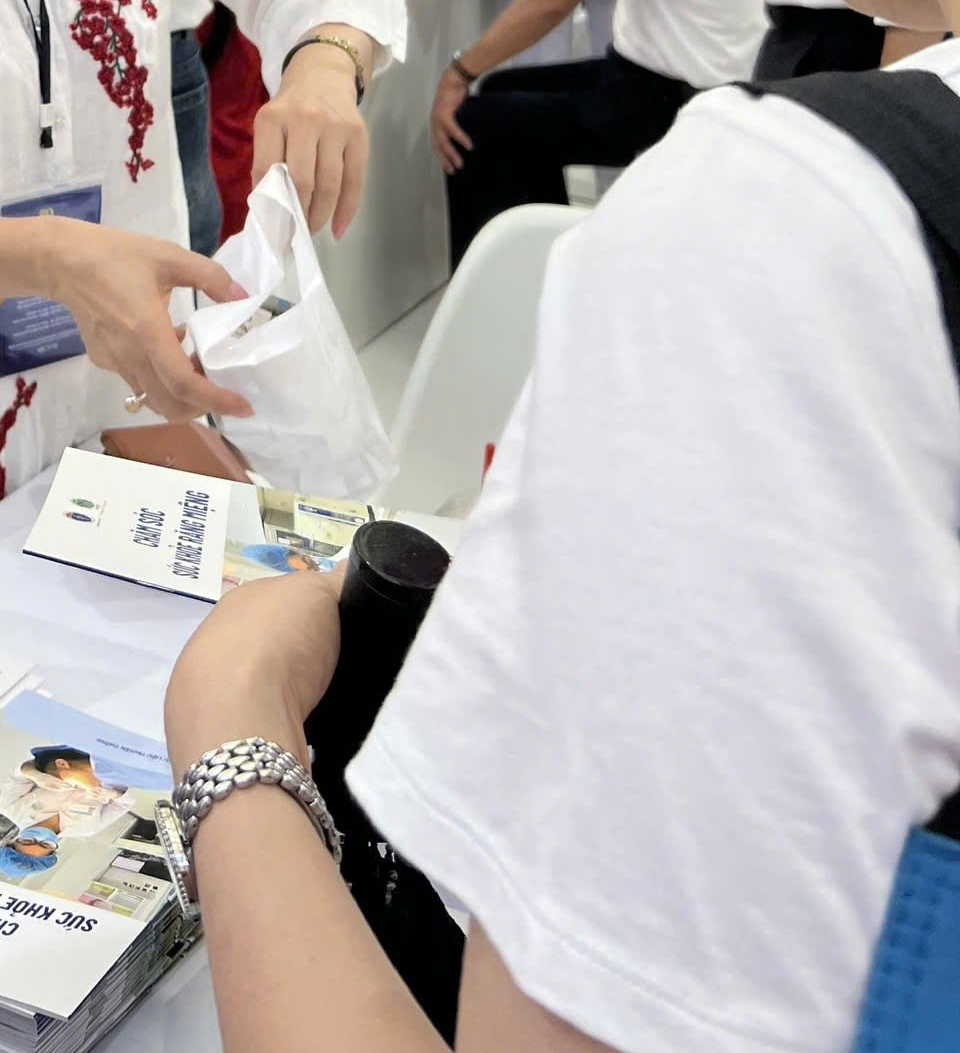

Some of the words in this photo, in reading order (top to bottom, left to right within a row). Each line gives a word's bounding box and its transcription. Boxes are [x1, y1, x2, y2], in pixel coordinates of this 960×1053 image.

[132, 507, 166, 527] SÓC
[177, 489, 217, 522] MIỆNG
[0, 896, 57, 921] KHỎE
[55, 911, 98, 933] SỨC
